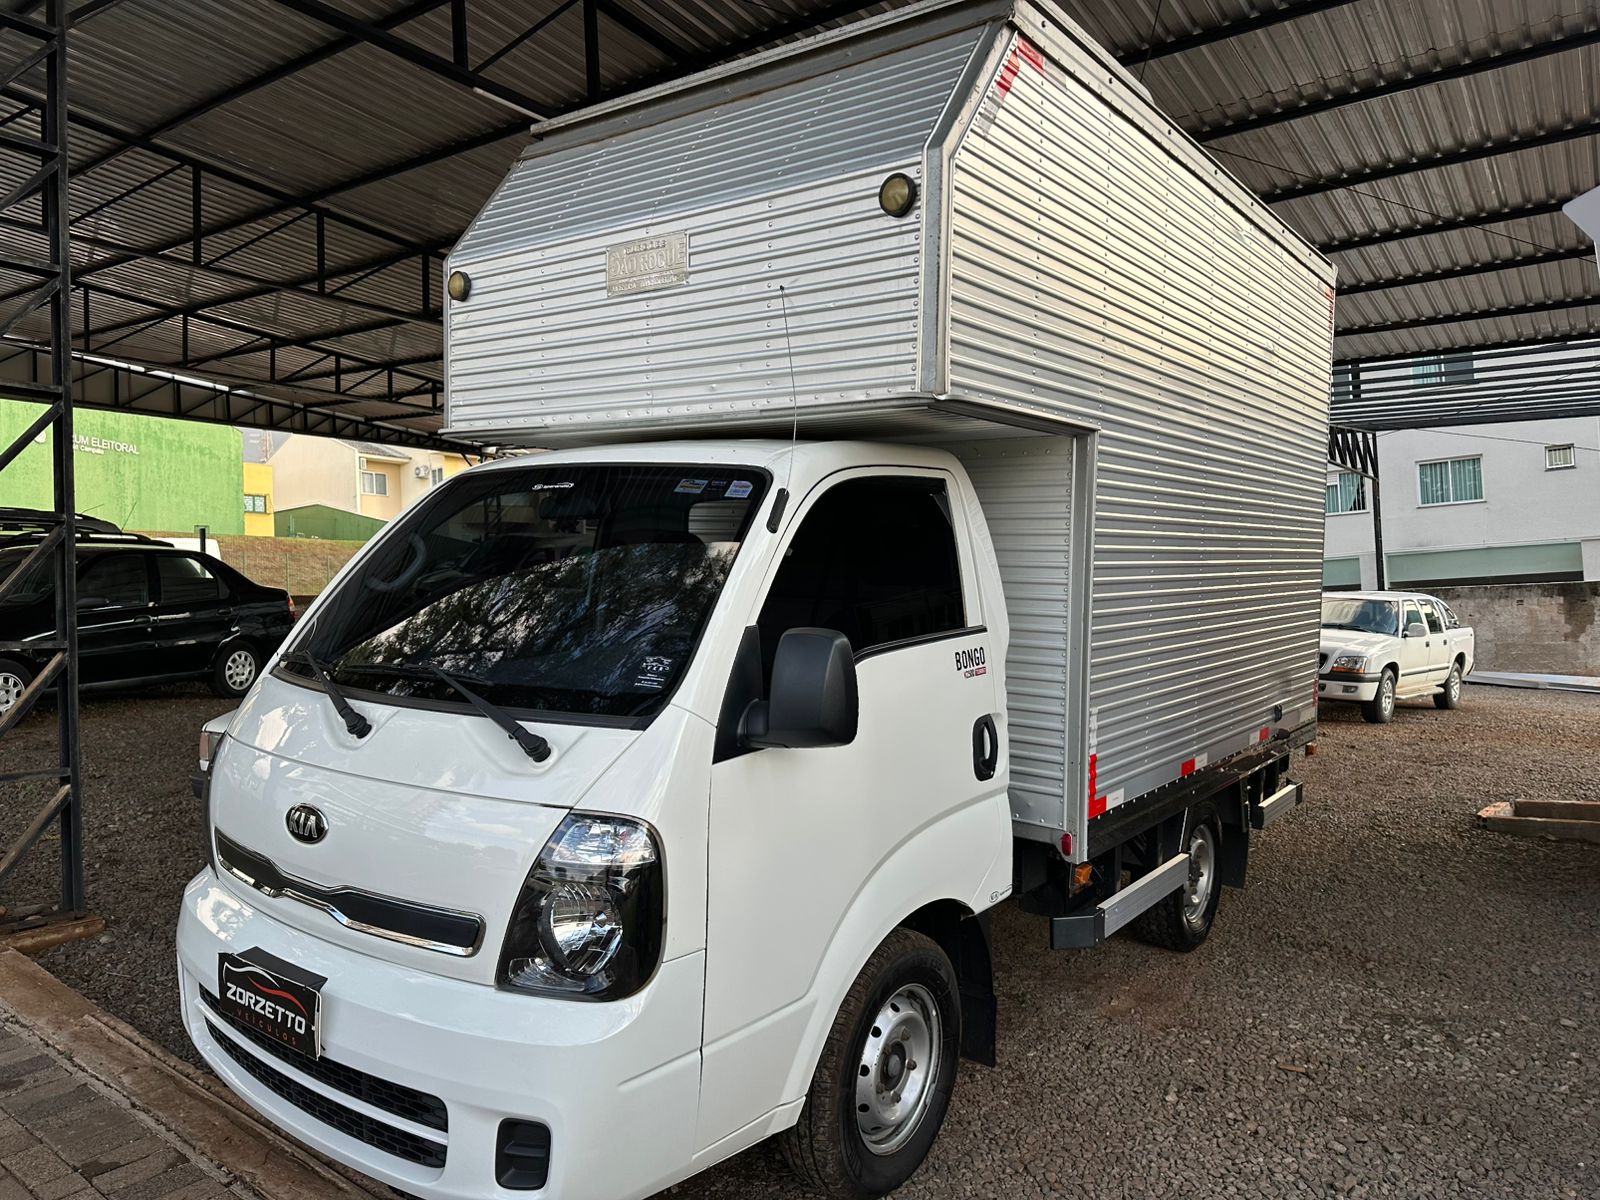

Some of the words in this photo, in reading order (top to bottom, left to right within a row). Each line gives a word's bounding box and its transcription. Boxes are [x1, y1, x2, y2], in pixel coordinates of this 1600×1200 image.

[91, 437, 140, 455] ELEITORAL
[955, 646, 986, 671] BONGO
[288, 809, 318, 838] KIA
[226, 982, 306, 1035] ZORZETTO
